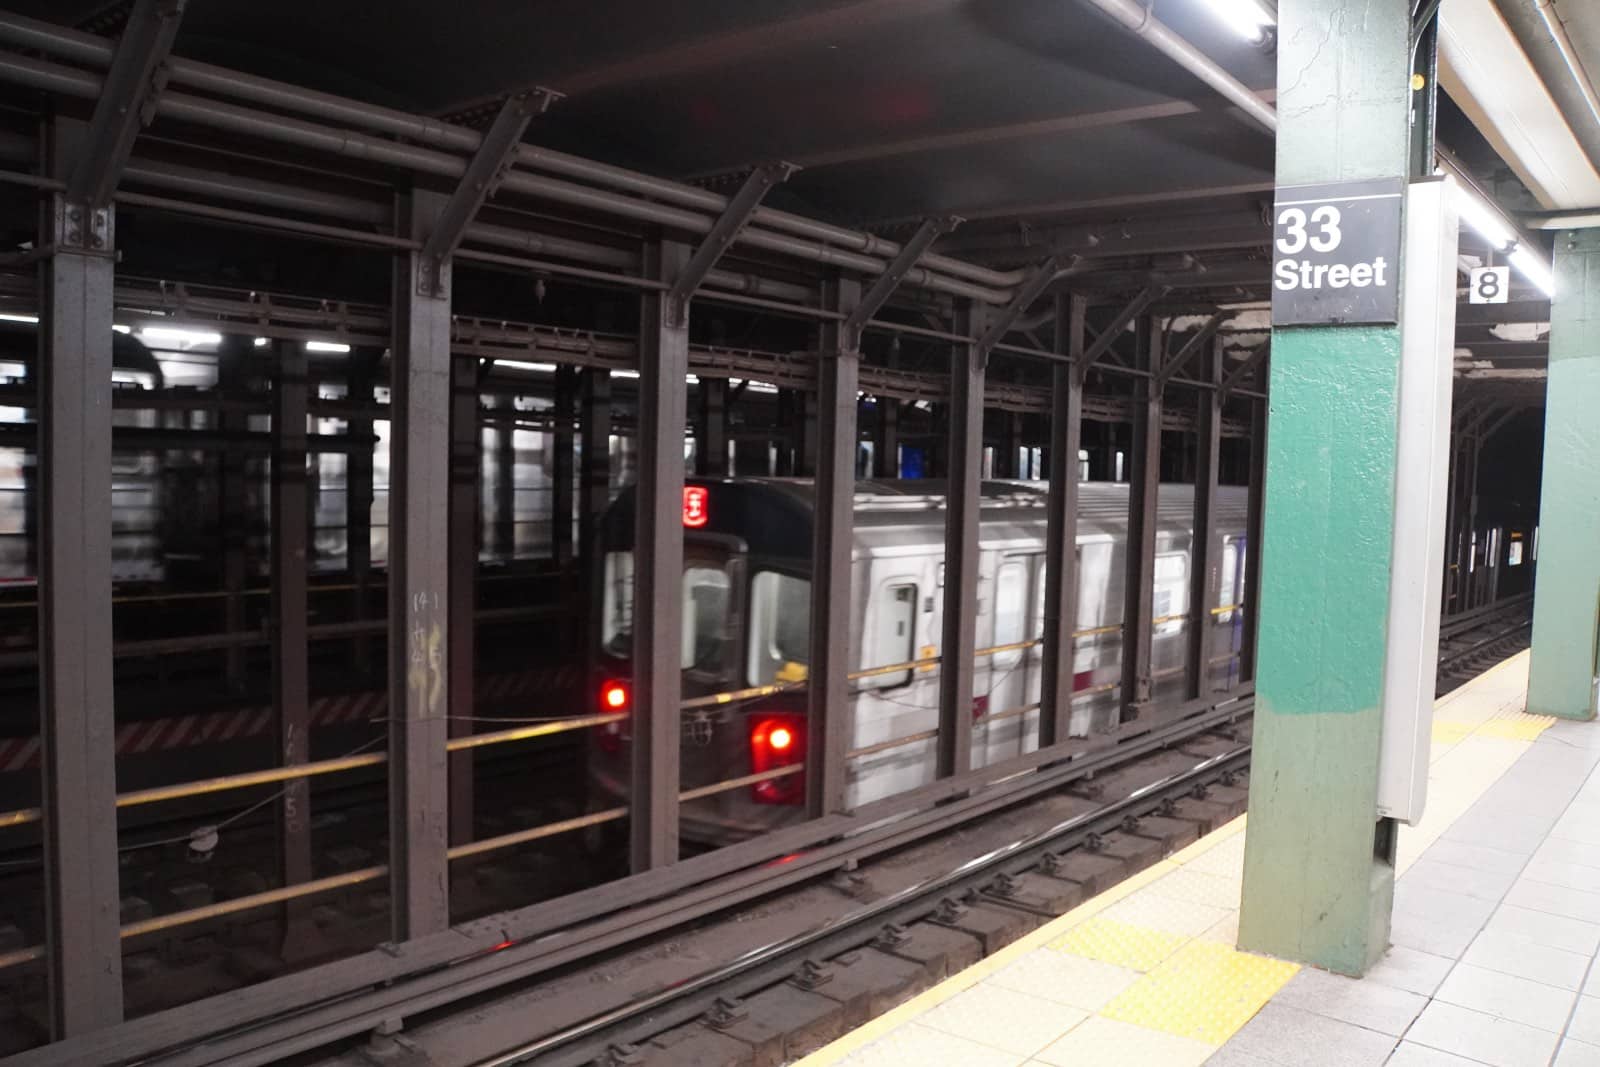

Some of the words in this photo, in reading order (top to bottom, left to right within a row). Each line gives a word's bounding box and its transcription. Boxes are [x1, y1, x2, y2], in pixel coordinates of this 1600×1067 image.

[1276, 205, 1342, 255] 33
[1274, 256, 1388, 291] Street
[1478, 271, 1500, 299] 8
